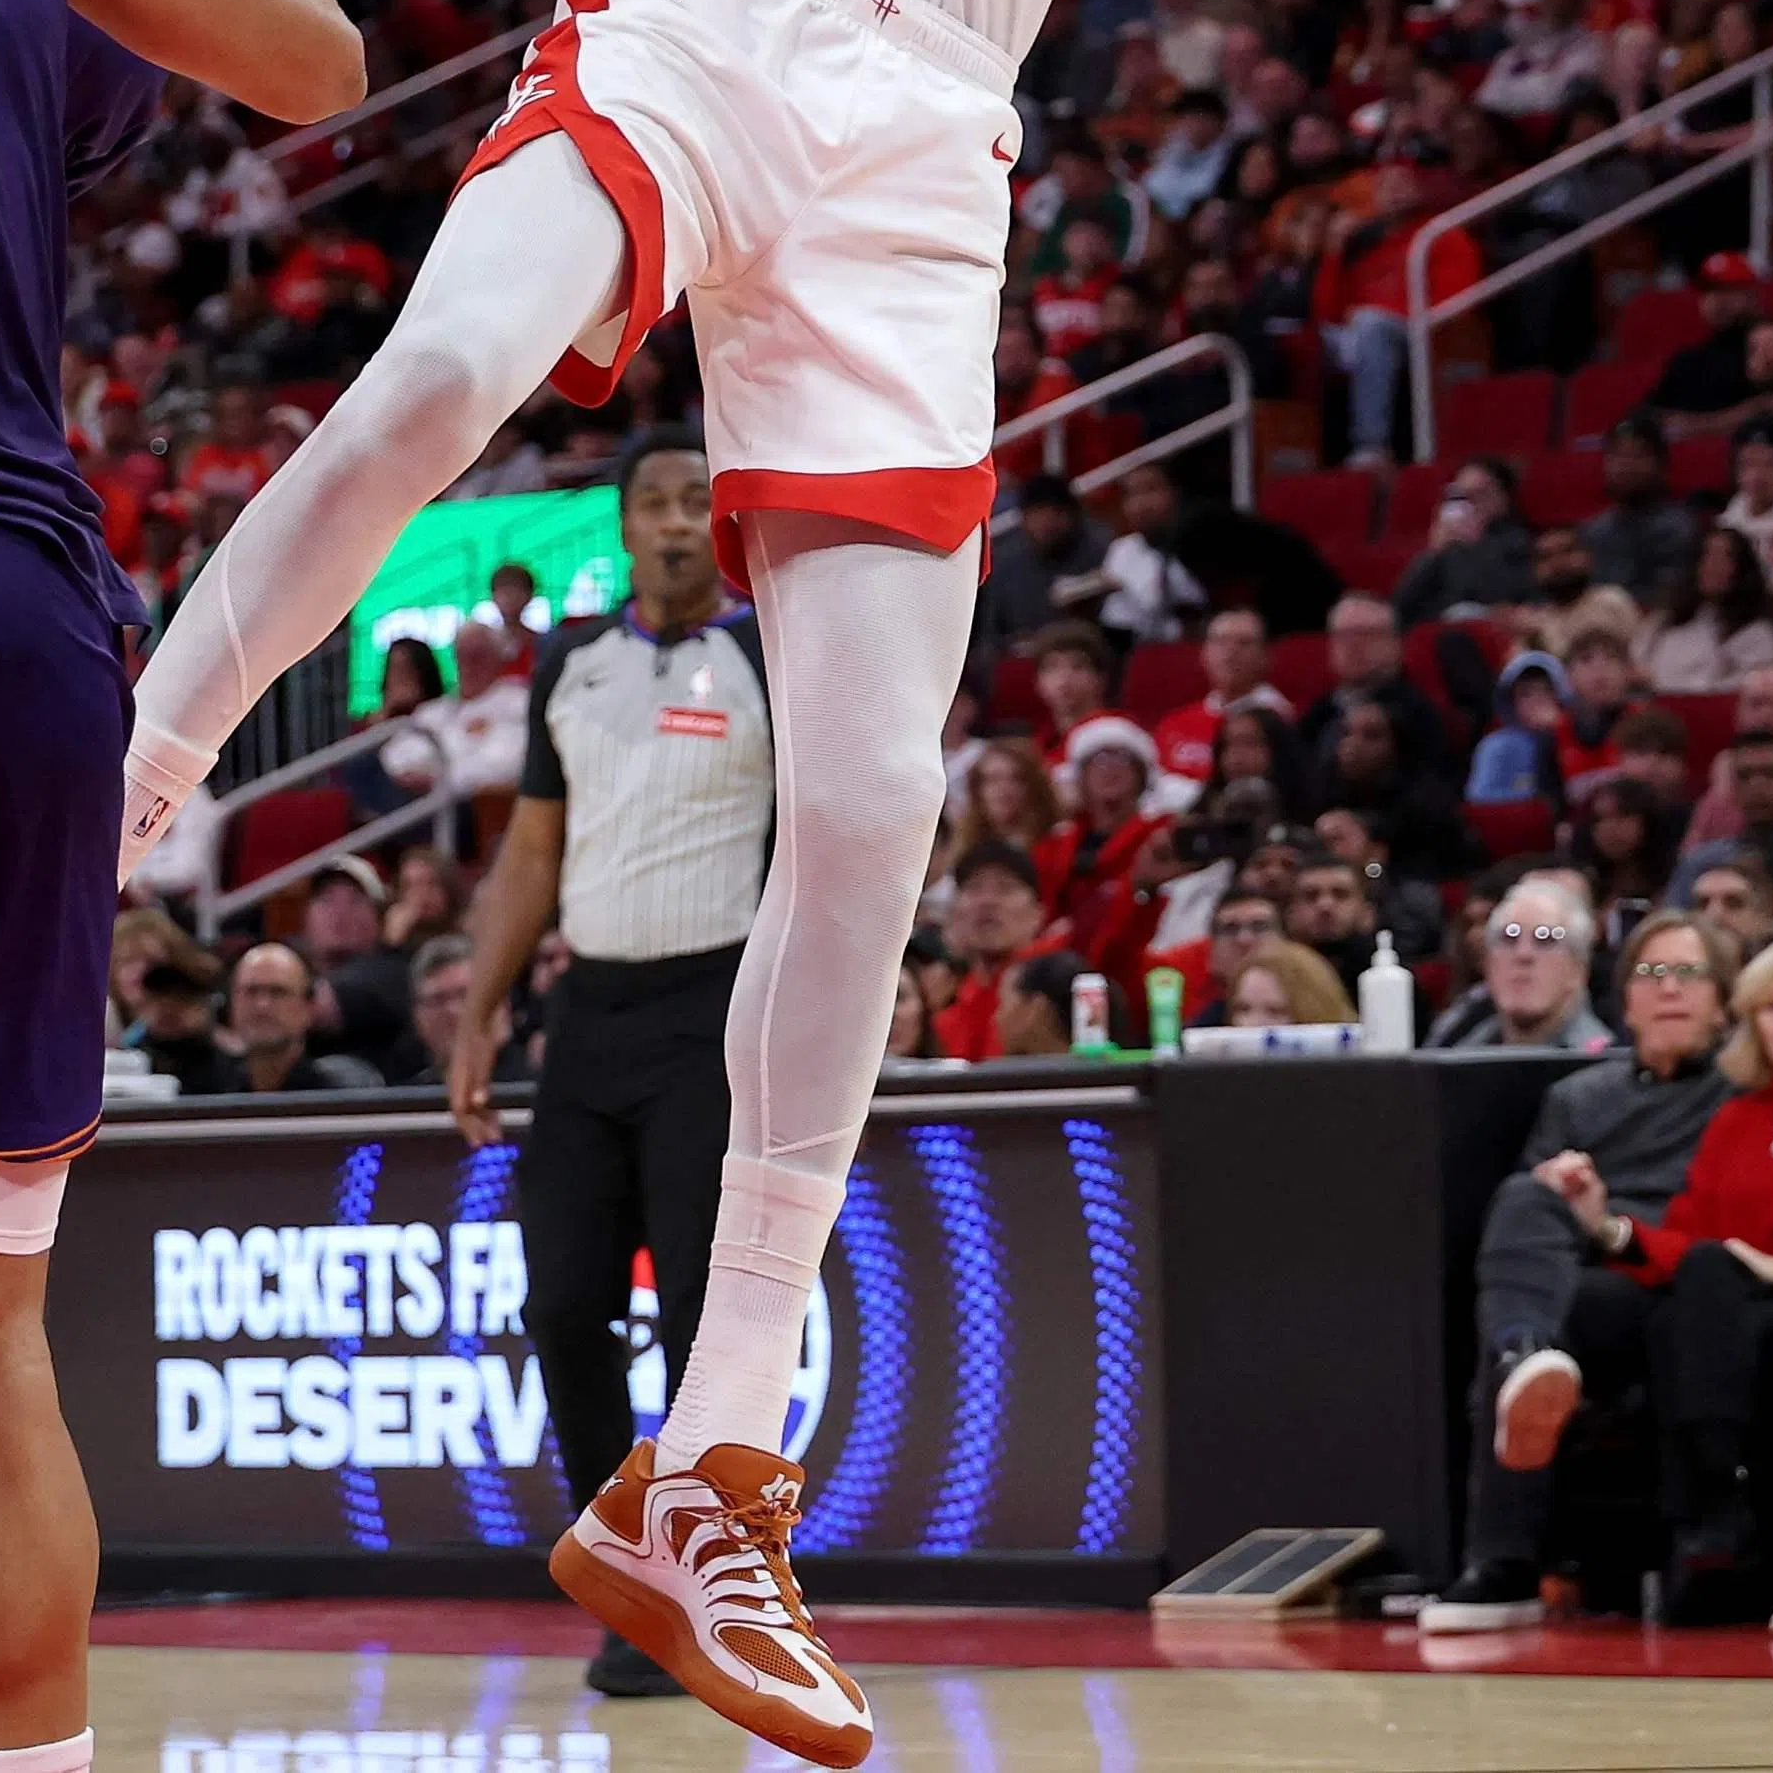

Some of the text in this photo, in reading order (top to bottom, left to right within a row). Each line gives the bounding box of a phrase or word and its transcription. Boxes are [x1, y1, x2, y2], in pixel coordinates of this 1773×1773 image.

[154, 1220, 529, 1342] ROCKETS FA
[155, 1354, 548, 1470] DESERV
